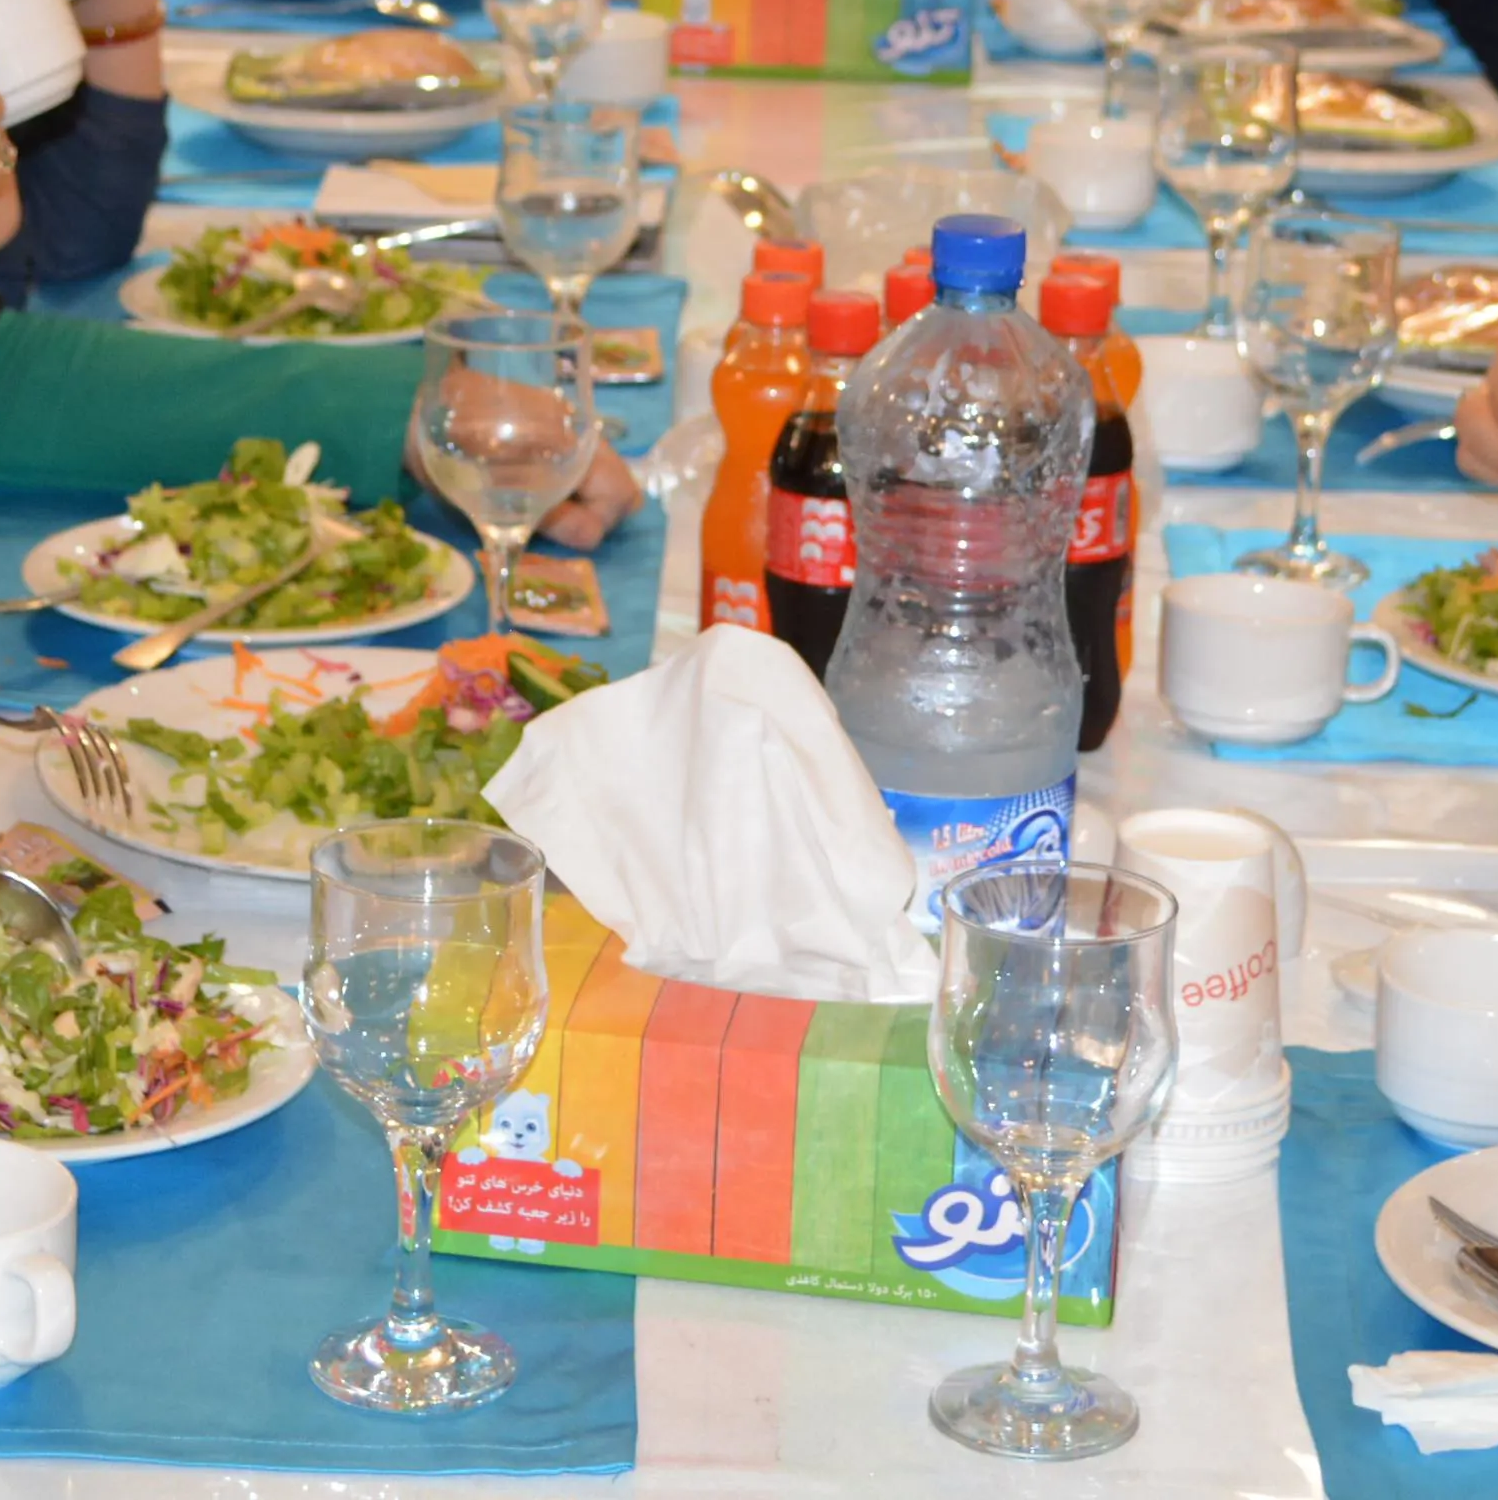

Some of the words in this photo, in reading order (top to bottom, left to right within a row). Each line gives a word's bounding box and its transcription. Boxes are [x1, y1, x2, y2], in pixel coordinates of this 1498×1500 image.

[1181, 939, 1278, 1007] Coffee
[480, 1175, 507, 1191] های
[511, 1180, 543, 1196] خرس
[548, 1183, 584, 1201] دنیای
[476, 1199, 514, 1215] کشف
[554, 1210, 577, 1226] زیر
[579, 1210, 591, 1227] را
